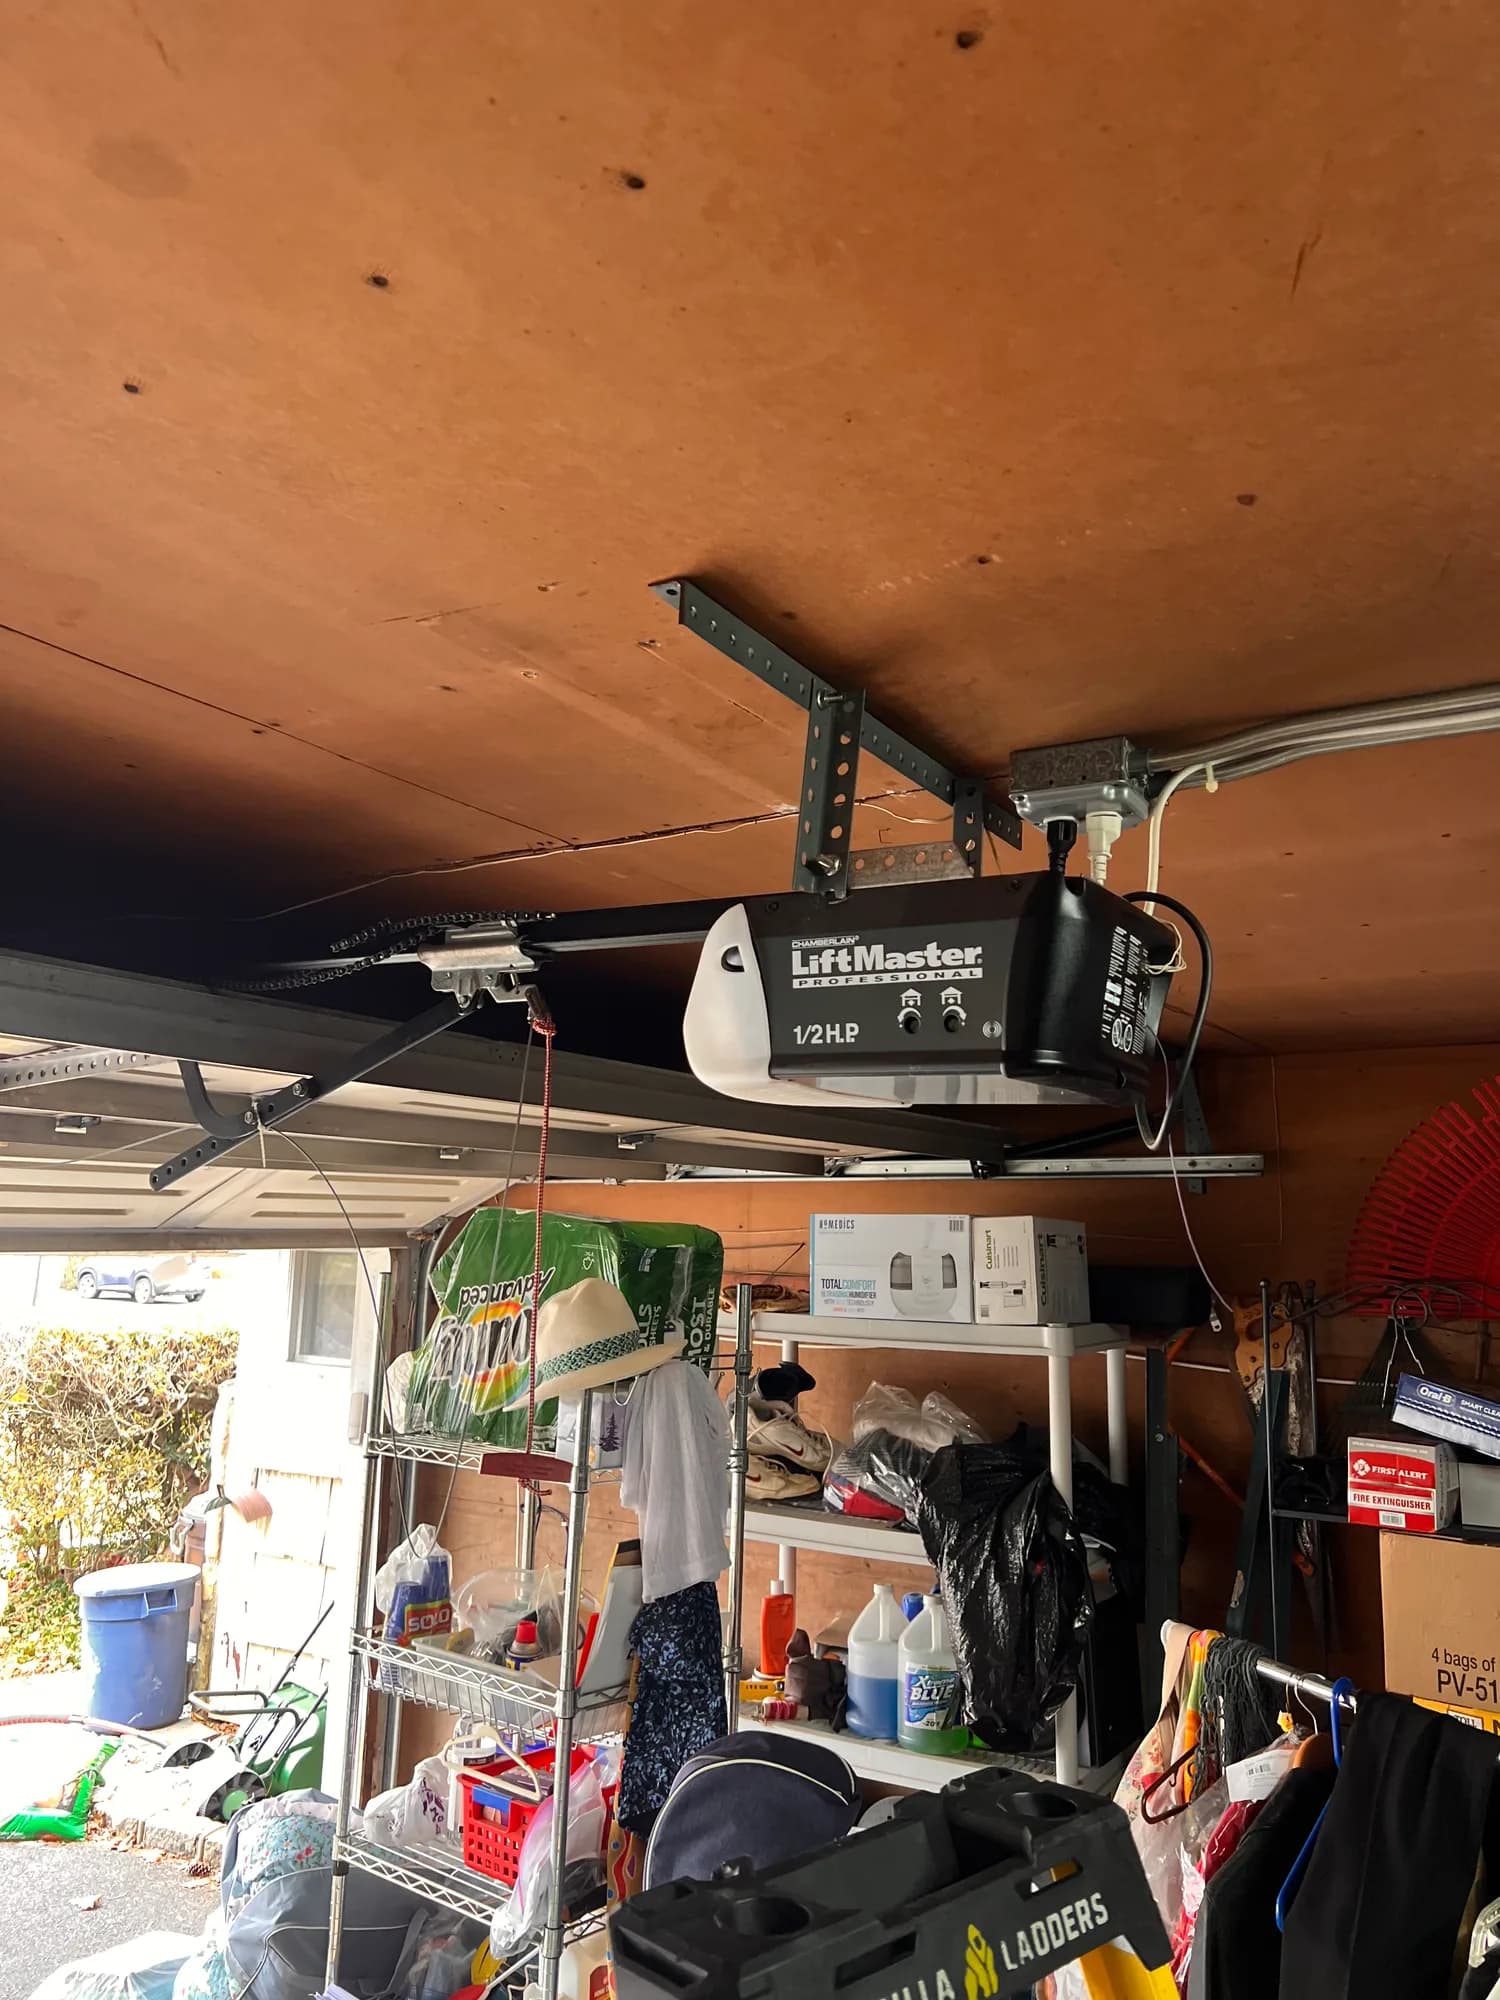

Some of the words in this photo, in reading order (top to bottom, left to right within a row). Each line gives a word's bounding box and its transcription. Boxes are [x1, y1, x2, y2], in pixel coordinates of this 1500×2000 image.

[792, 942, 982, 975] LiftMaster
[798, 970, 978, 987] PROFESSIONAL
[793, 1024, 823, 1045] 1/2
[985, 1229, 993, 1269] Cuisinart
[459, 1268, 555, 1315] Advanced
[650, 1304, 662, 1346] SHEETS
[704, 1287, 715, 1340] DURABLE
[1419, 1386, 1453, 1404] Oral-B
[1461, 1399, 1483, 1411] SMART
[1372, 1465, 1397, 1476] FIRST
[1398, 1469, 1428, 1480] ALERT
[1353, 1493, 1370, 1503] FIRE
[1372, 1495, 1431, 1511] EXTINGUISHER
[1431, 1647, 1439, 1663] 4
[1443, 1648, 1477, 1672] bags
[1482, 1657, 1496, 1672] of
[909, 1684, 955, 1700] BLUE
[1000, 1891, 1109, 1971] LADDERS
